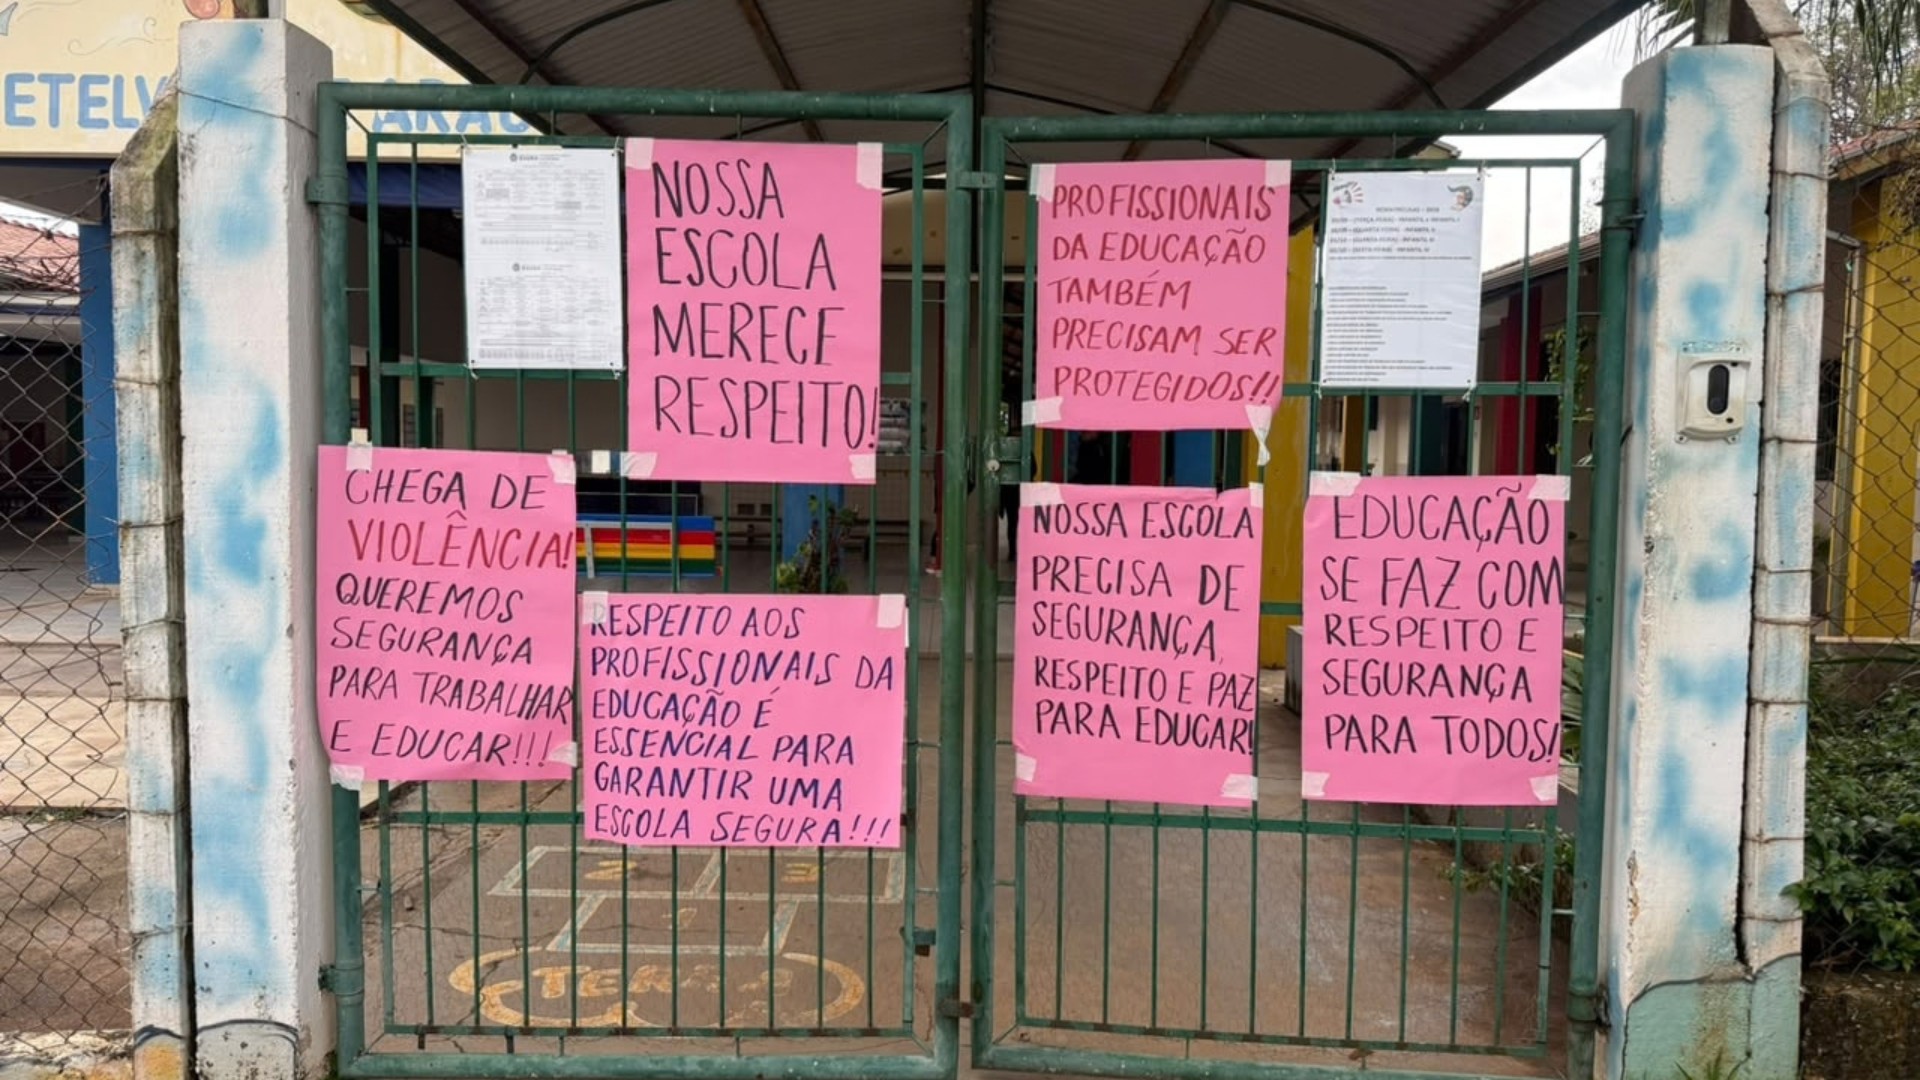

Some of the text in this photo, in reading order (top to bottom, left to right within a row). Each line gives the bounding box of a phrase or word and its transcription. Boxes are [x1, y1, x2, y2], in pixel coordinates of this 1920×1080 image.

[651, 158, 784, 220] NOSSA
[1052, 183, 1276, 222] PROFISSIONAIS
[655, 227, 837, 291] ESCOLA
[1053, 228, 1265, 266] DA EDUCAÇÃO
[1048, 270, 1191, 310] TAMBÉM
[652, 302, 844, 365] MERECE
[1053, 317, 1276, 356] PRECISAM SER
[1054, 366, 1280, 404] PROTEGIDOS!!
[655, 375, 878, 450] RESPEITO!
[345, 469, 547, 510] CHEGA DE
[348, 510, 574, 570] VIOLÊNCIA!
[1033, 501, 1254, 539] NOSSA ESCOLA
[1333, 482, 1550, 552] EDUCAÇÃO
[334, 572, 524, 623] QUEREMOS
[1032, 555, 1244, 611] PRECISA DE
[1320, 556, 1565, 609] SE FAZ COM
[330, 616, 532, 666] SEGURANÇA
[591, 603, 805, 639] RESPEITO AOS
[1032, 601, 1224, 665] SEGURANÇA,
[1324, 613, 1538, 652] RESPEITO E
[591, 646, 893, 691] PROFISSIONAIS DA
[1035, 656, 1255, 713] RESPEITO E PAZ
[1322, 658, 1532, 703] SEGURANÇA
[329, 664, 574, 725] PARA TRABALHAR
[592, 687, 779, 729] EDUCAÇÃO É
[330, 719, 552, 767] E EDUCAR!!!
[594, 727, 854, 767] ESSENCIAL PARA
[1036, 699, 1254, 756] PARA EDUCAR!
[1325, 714, 1560, 763] PARA TODOS!
[594, 761, 842, 812] GARANTIR UMA
[594, 803, 891, 844] ESCOLA SEGURA!!!
